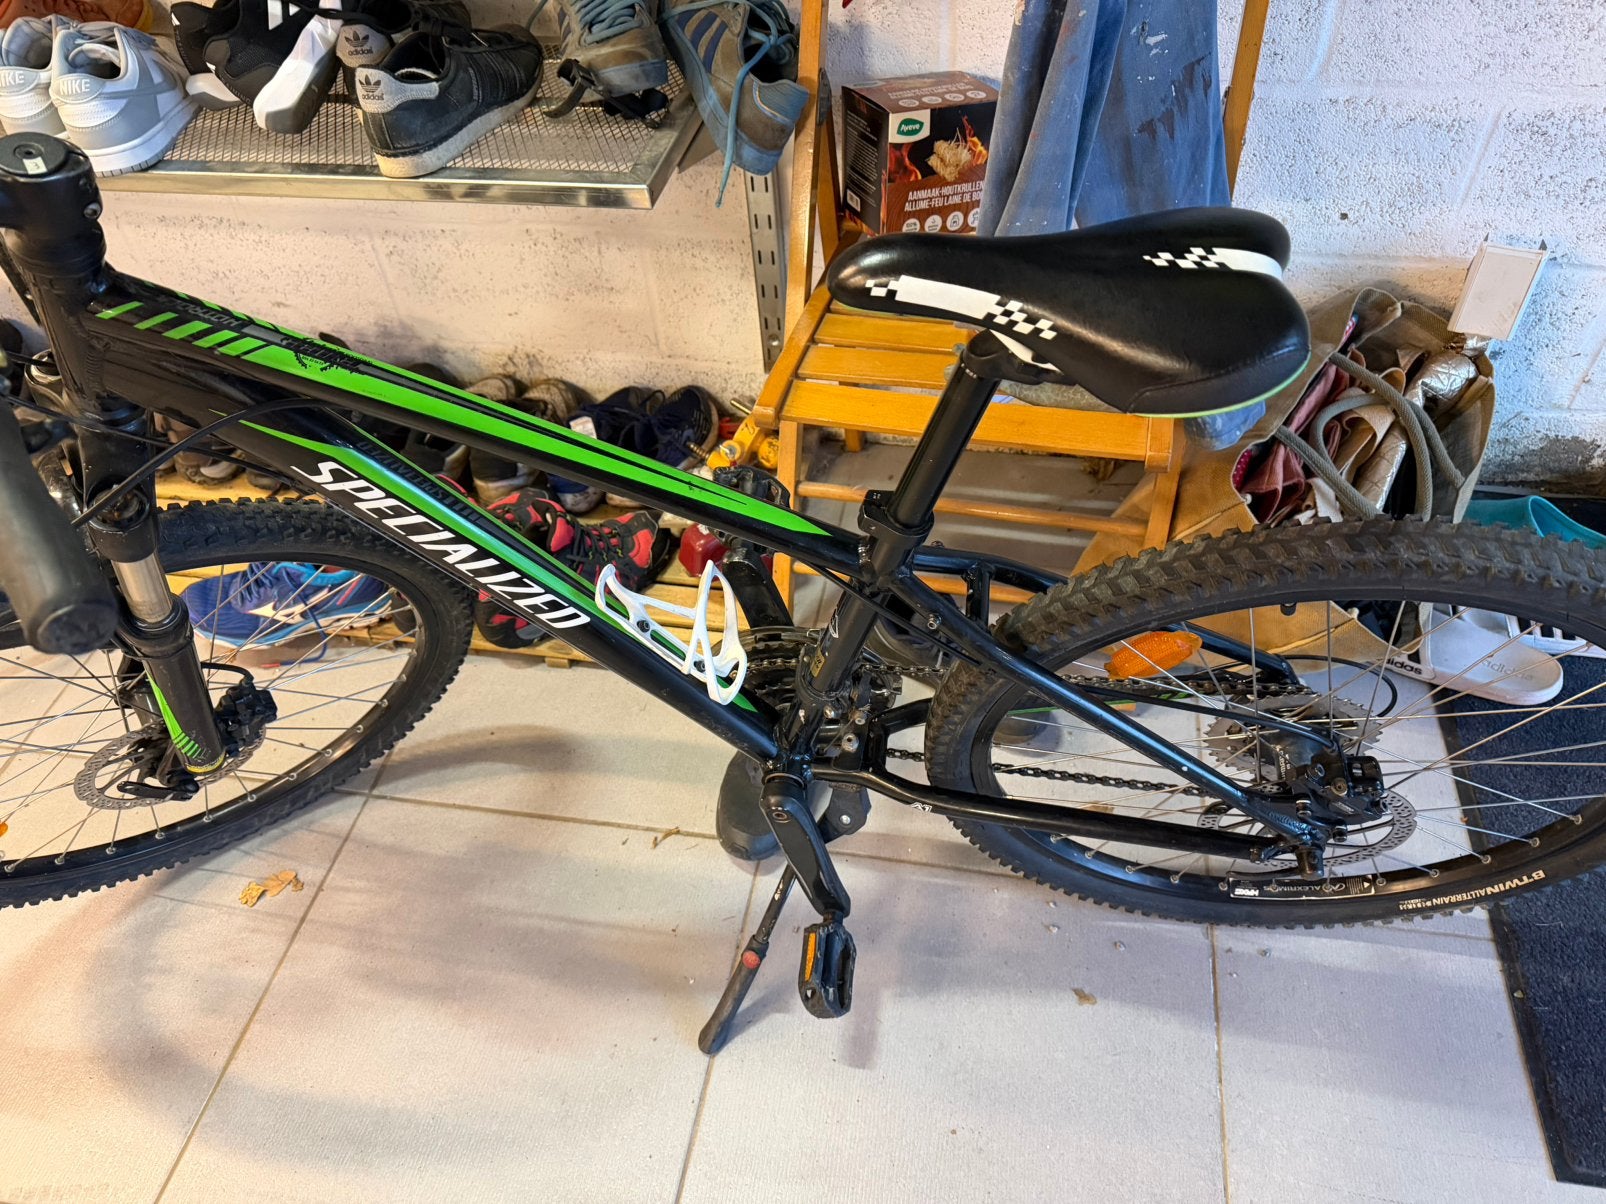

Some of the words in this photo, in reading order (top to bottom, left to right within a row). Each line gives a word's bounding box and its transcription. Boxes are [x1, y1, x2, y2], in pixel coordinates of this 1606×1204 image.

[348, 46, 374, 56] adidas
[0, 71, 25, 87] IKE
[59, 78, 91, 96] NIKE
[361, 93, 385, 101] adidas
[291, 461, 591, 629] SPECIALIZED
[1431, 889, 1486, 906] ALLTERRAIN
